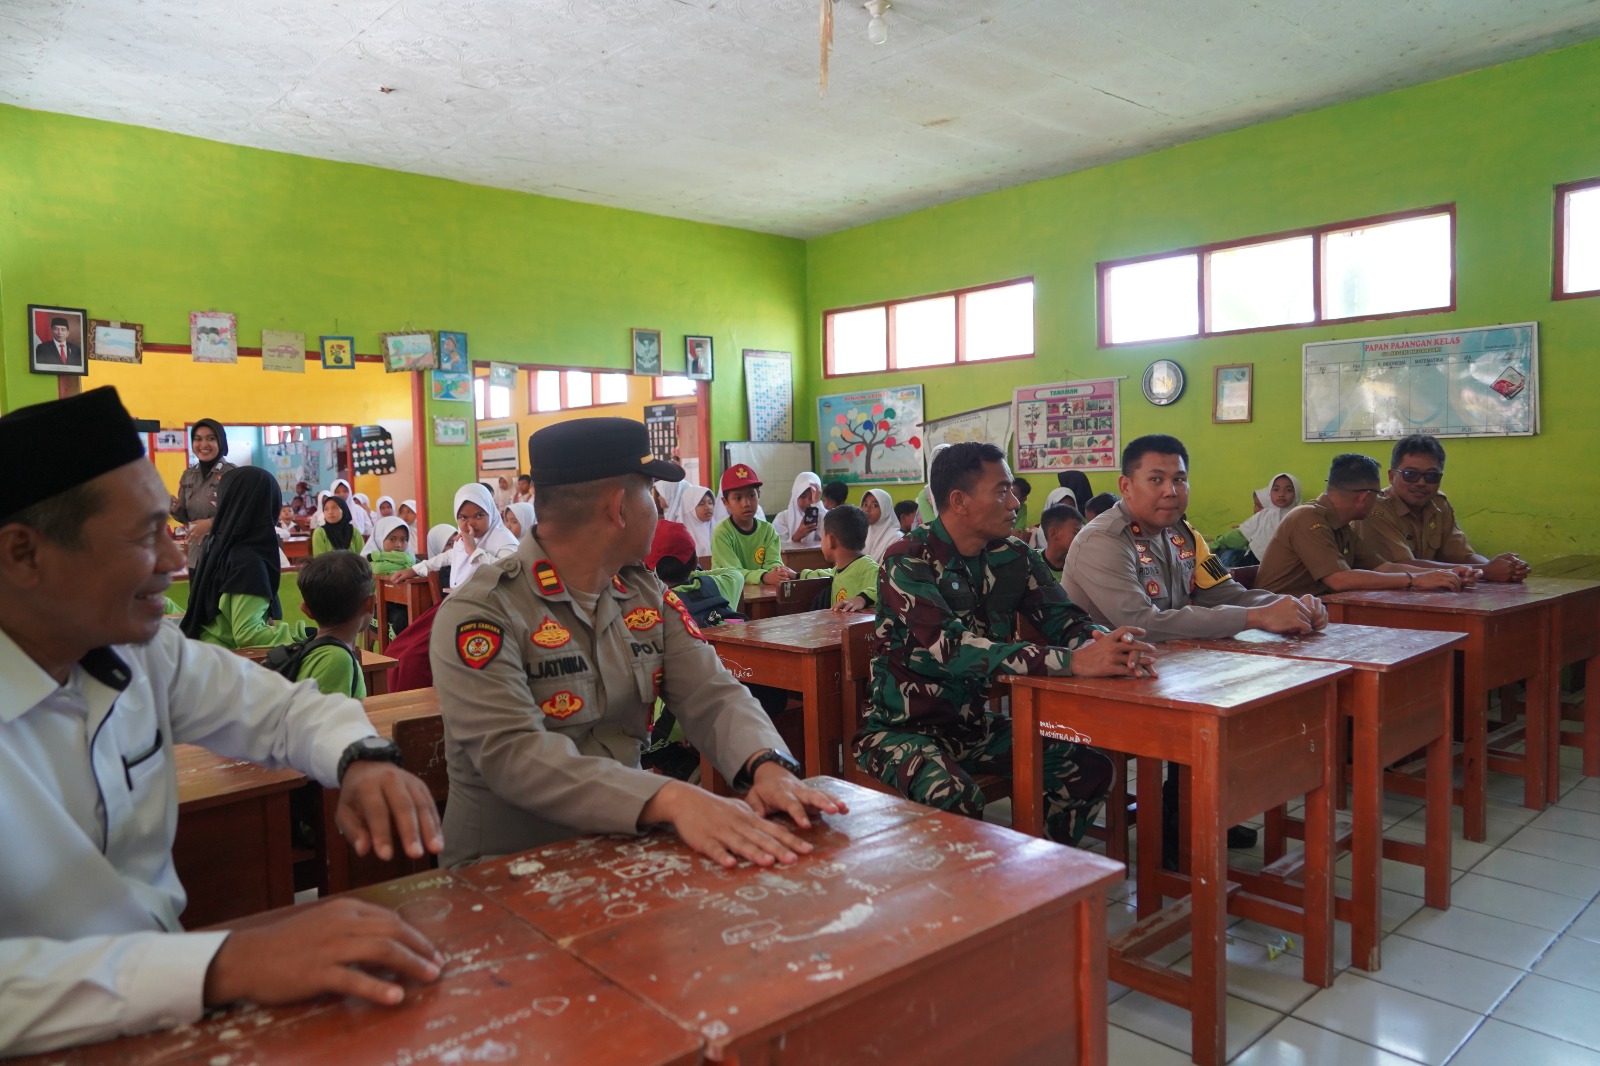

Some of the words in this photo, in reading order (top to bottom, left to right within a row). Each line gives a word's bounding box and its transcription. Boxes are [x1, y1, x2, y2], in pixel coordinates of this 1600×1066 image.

[1364, 343, 1389, 352] PAPAN
[1390, 340, 1431, 349] PAJANGAN
[1433, 337, 1460, 346] KELAS
[1050, 388, 1078, 396] TANAMAN
